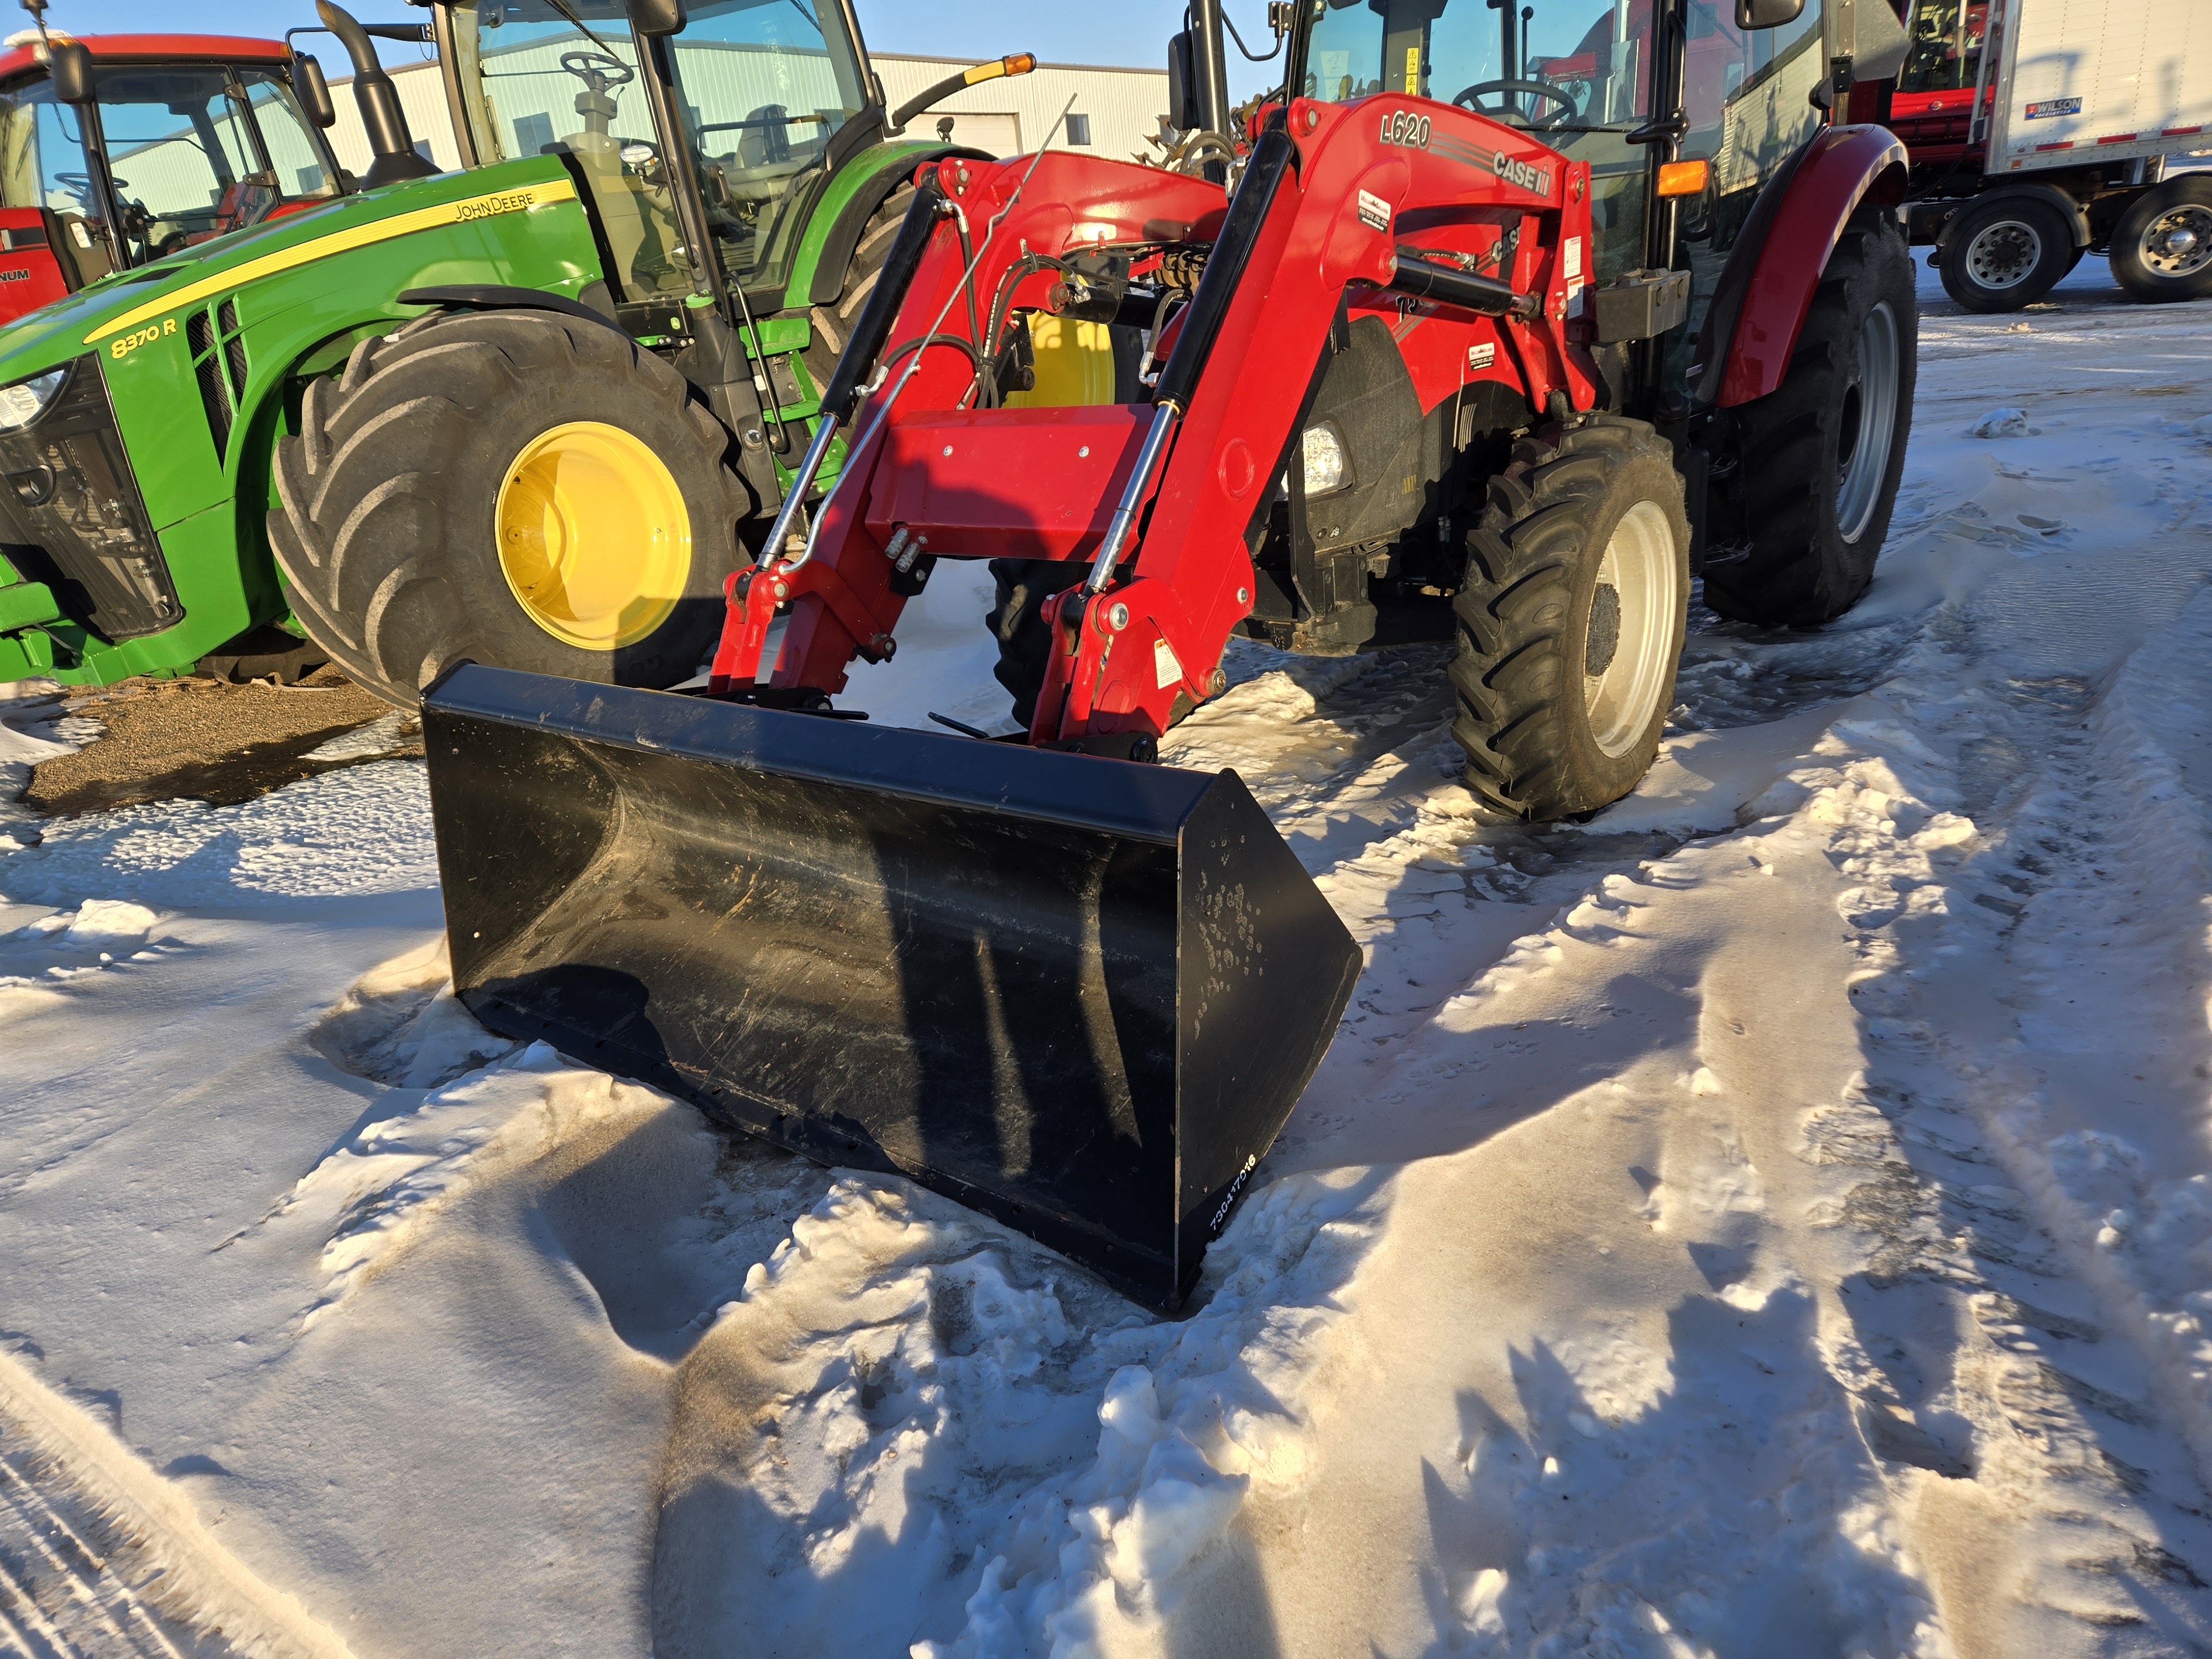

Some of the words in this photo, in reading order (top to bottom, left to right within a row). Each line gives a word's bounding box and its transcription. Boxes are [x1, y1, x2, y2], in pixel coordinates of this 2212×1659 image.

[2037, 98, 2081, 113] WILSON
[1379, 109, 1431, 150] L620
[1493, 150, 1537, 190] CASE
[456, 201, 492, 220] JOHN
[489, 193, 535, 211] DEERE
[111, 325, 159, 359] 8370
[163, 319, 177, 336] R
